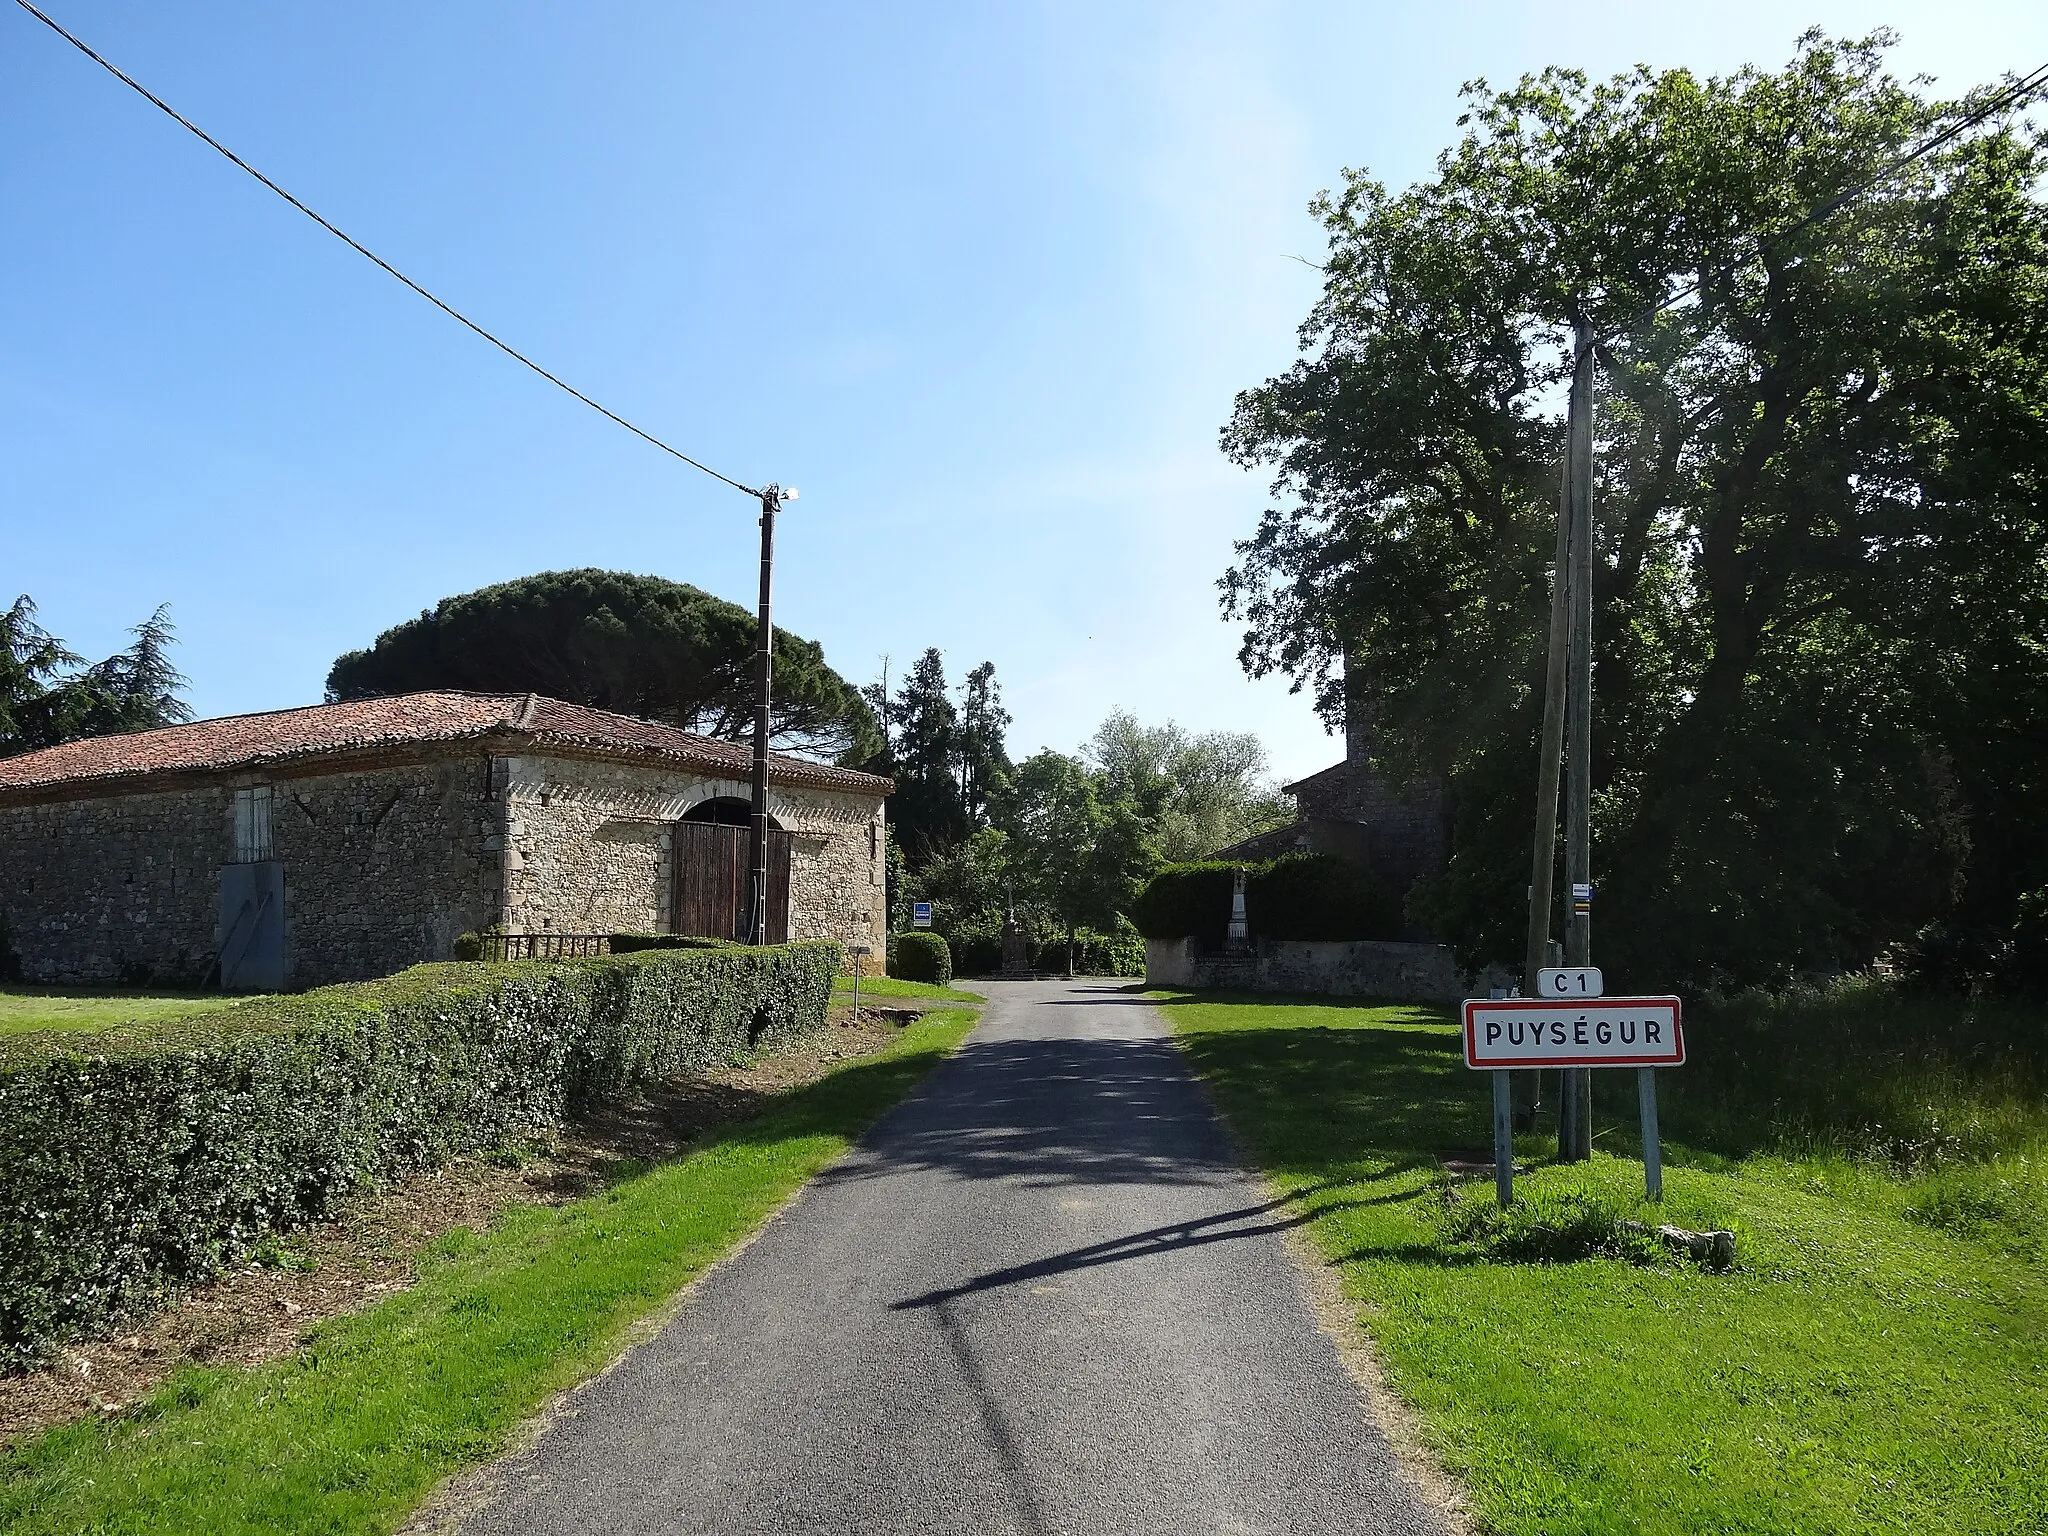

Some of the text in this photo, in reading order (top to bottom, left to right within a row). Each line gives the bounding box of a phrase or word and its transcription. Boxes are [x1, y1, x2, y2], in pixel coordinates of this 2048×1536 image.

[1554, 973, 1586, 992] C 1
[1486, 1016, 1661, 1046] PUYSÉGUR
